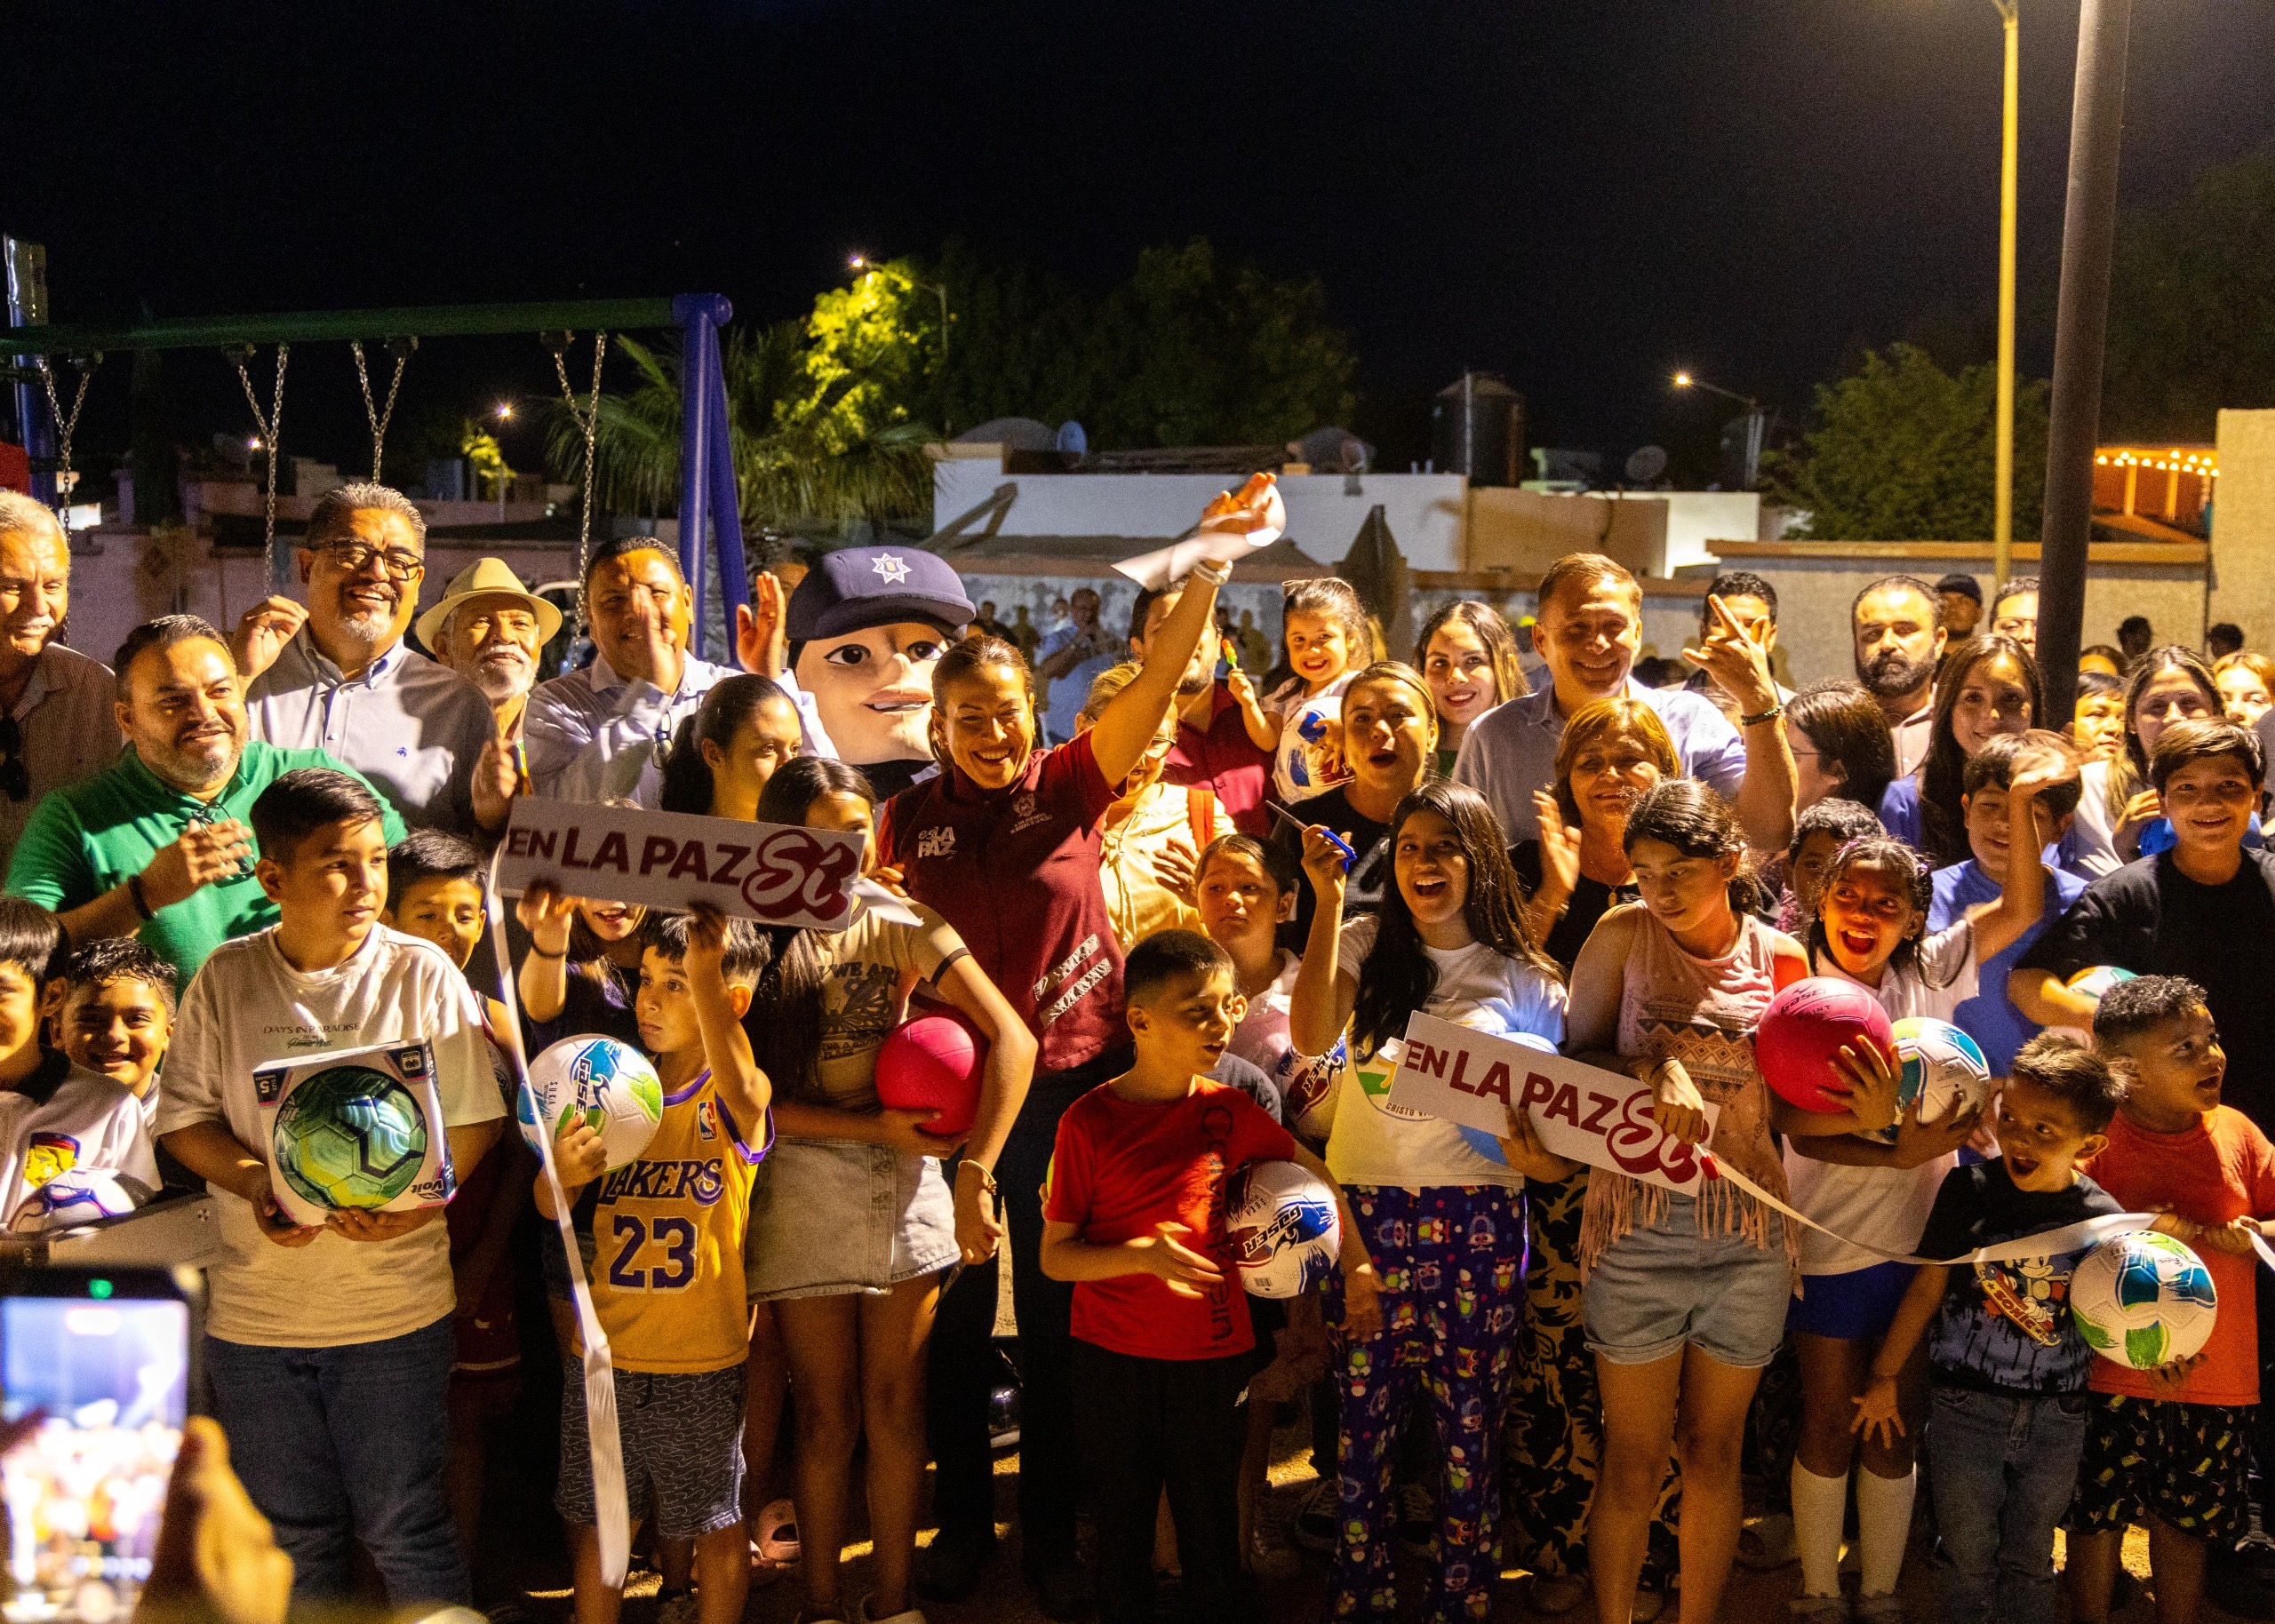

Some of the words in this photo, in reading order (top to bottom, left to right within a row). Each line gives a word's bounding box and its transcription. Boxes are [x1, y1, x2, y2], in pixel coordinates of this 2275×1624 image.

[507, 827, 558, 859] EN
[560, 825, 628, 874] LA
[639, 835, 751, 887] PAZ
[263, 1025, 293, 1034] DAYS
[308, 1023, 361, 1033] PARADISE
[259, 1079, 270, 1094] 5
[548, 1081, 558, 1105] SUKA
[1404, 1038, 1450, 1079] EN
[1449, 1049, 1512, 1107] LA
[1518, 1071, 1619, 1136] PAZ
[1385, 1102, 1415, 1117] CRISTO
[411, 1179, 443, 1194] Voit
[597, 1158, 725, 1207] LAKERS
[610, 1214, 698, 1294] 23
[1993, 1289, 2036, 1330] SONIC
